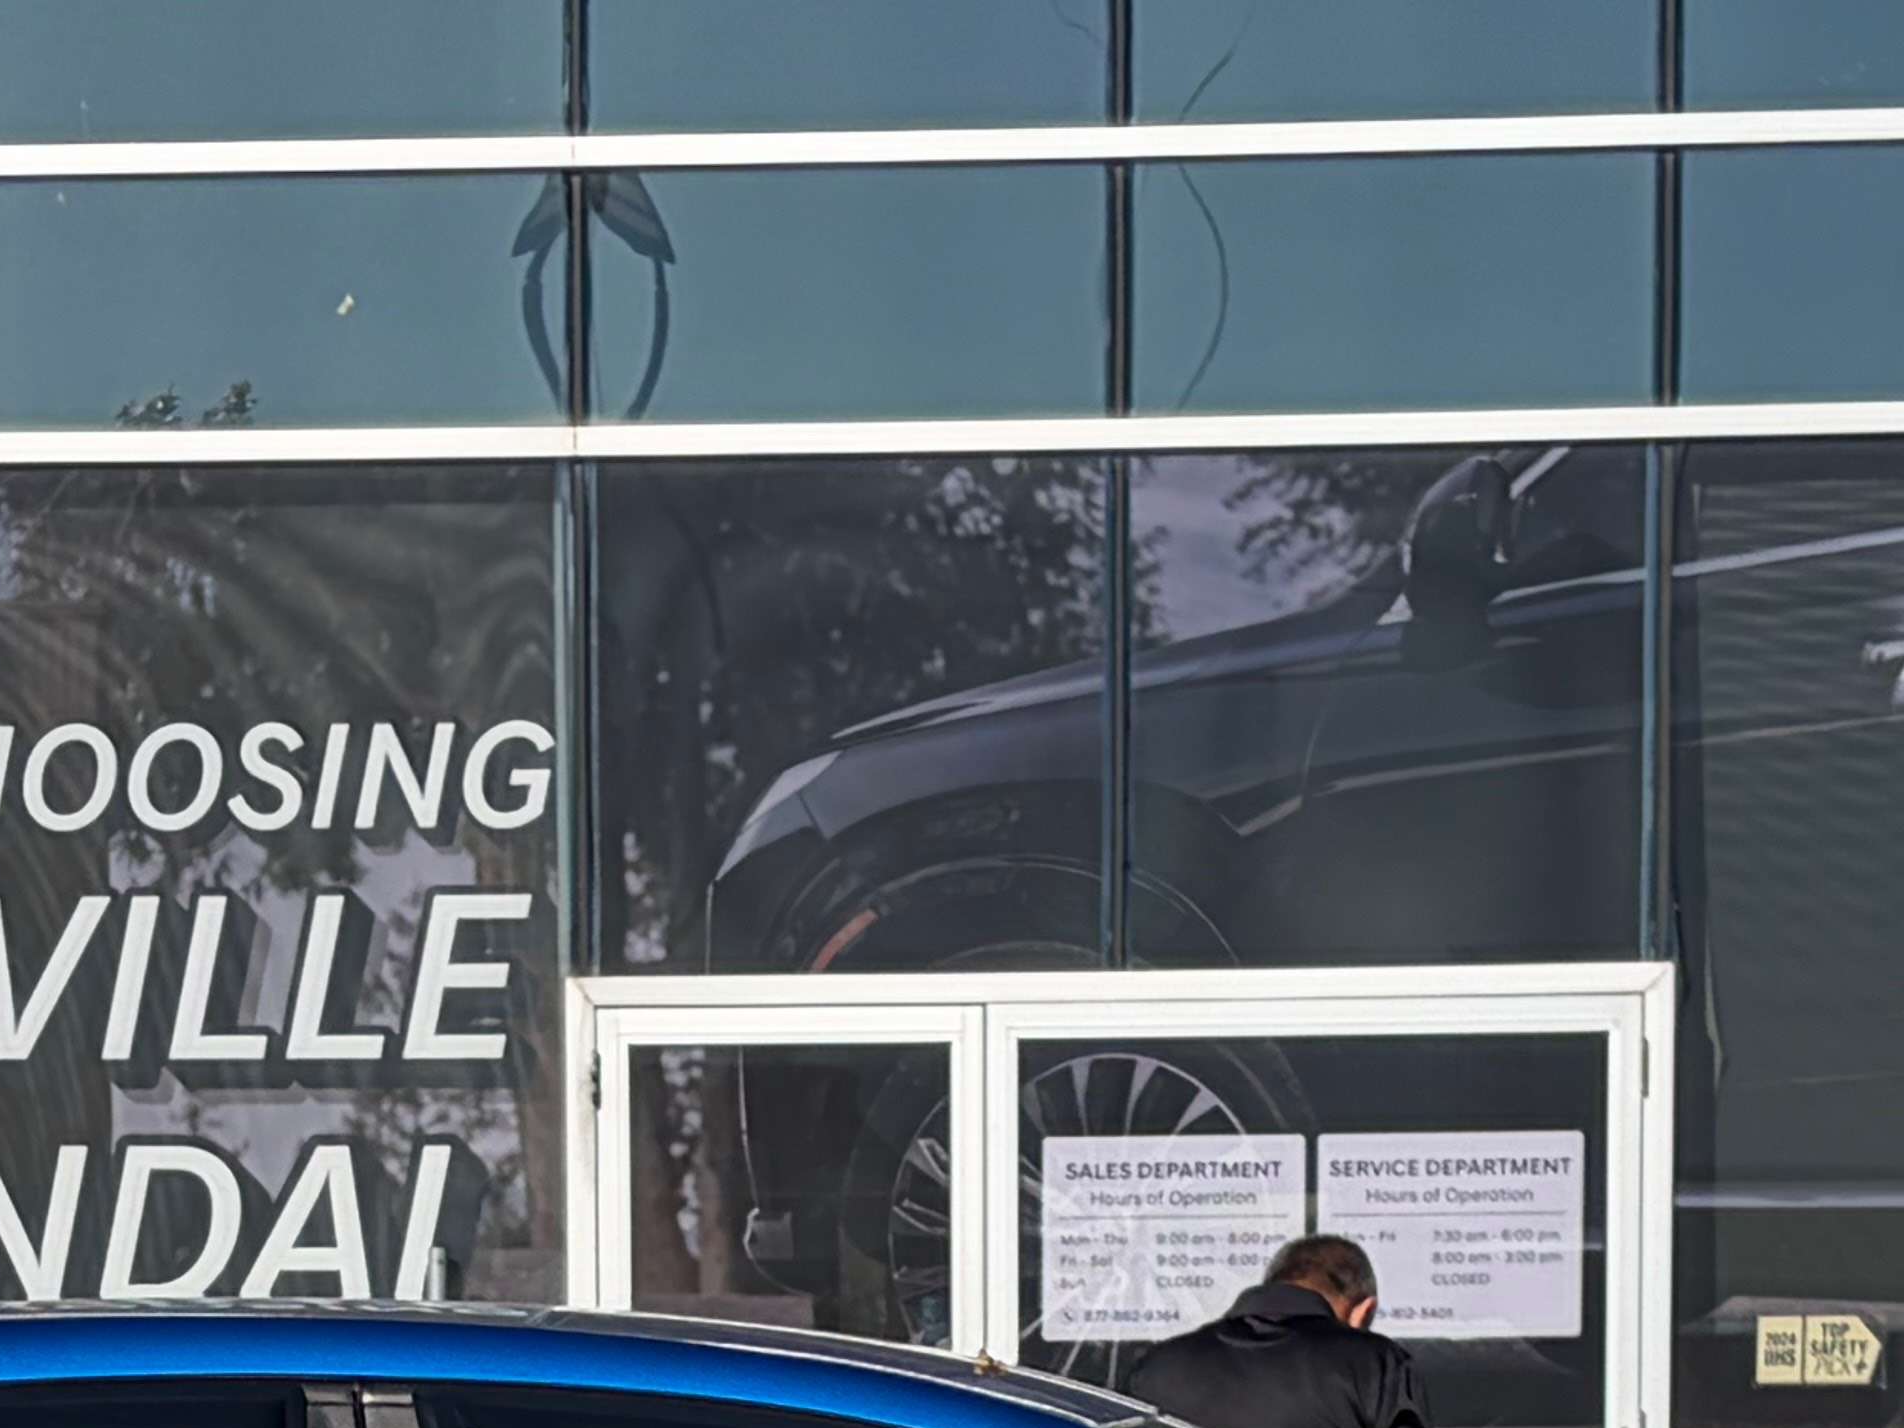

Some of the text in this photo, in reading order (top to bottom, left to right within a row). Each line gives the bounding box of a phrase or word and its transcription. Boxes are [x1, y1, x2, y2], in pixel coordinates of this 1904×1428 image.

[1065, 1161, 1282, 1180] SALES DEPARTMENT
[1329, 1157, 1571, 1177] SERVICE DEPARTMENT
[1090, 1191, 1258, 1208] Hours of Operation
[1365, 1187, 1534, 1205] Hours of Operation
[1156, 1276, 1214, 1288] CLOSED
[1432, 1273, 1491, 1286] CLOSED
[1810, 1339, 1868, 1357] SAFETY
